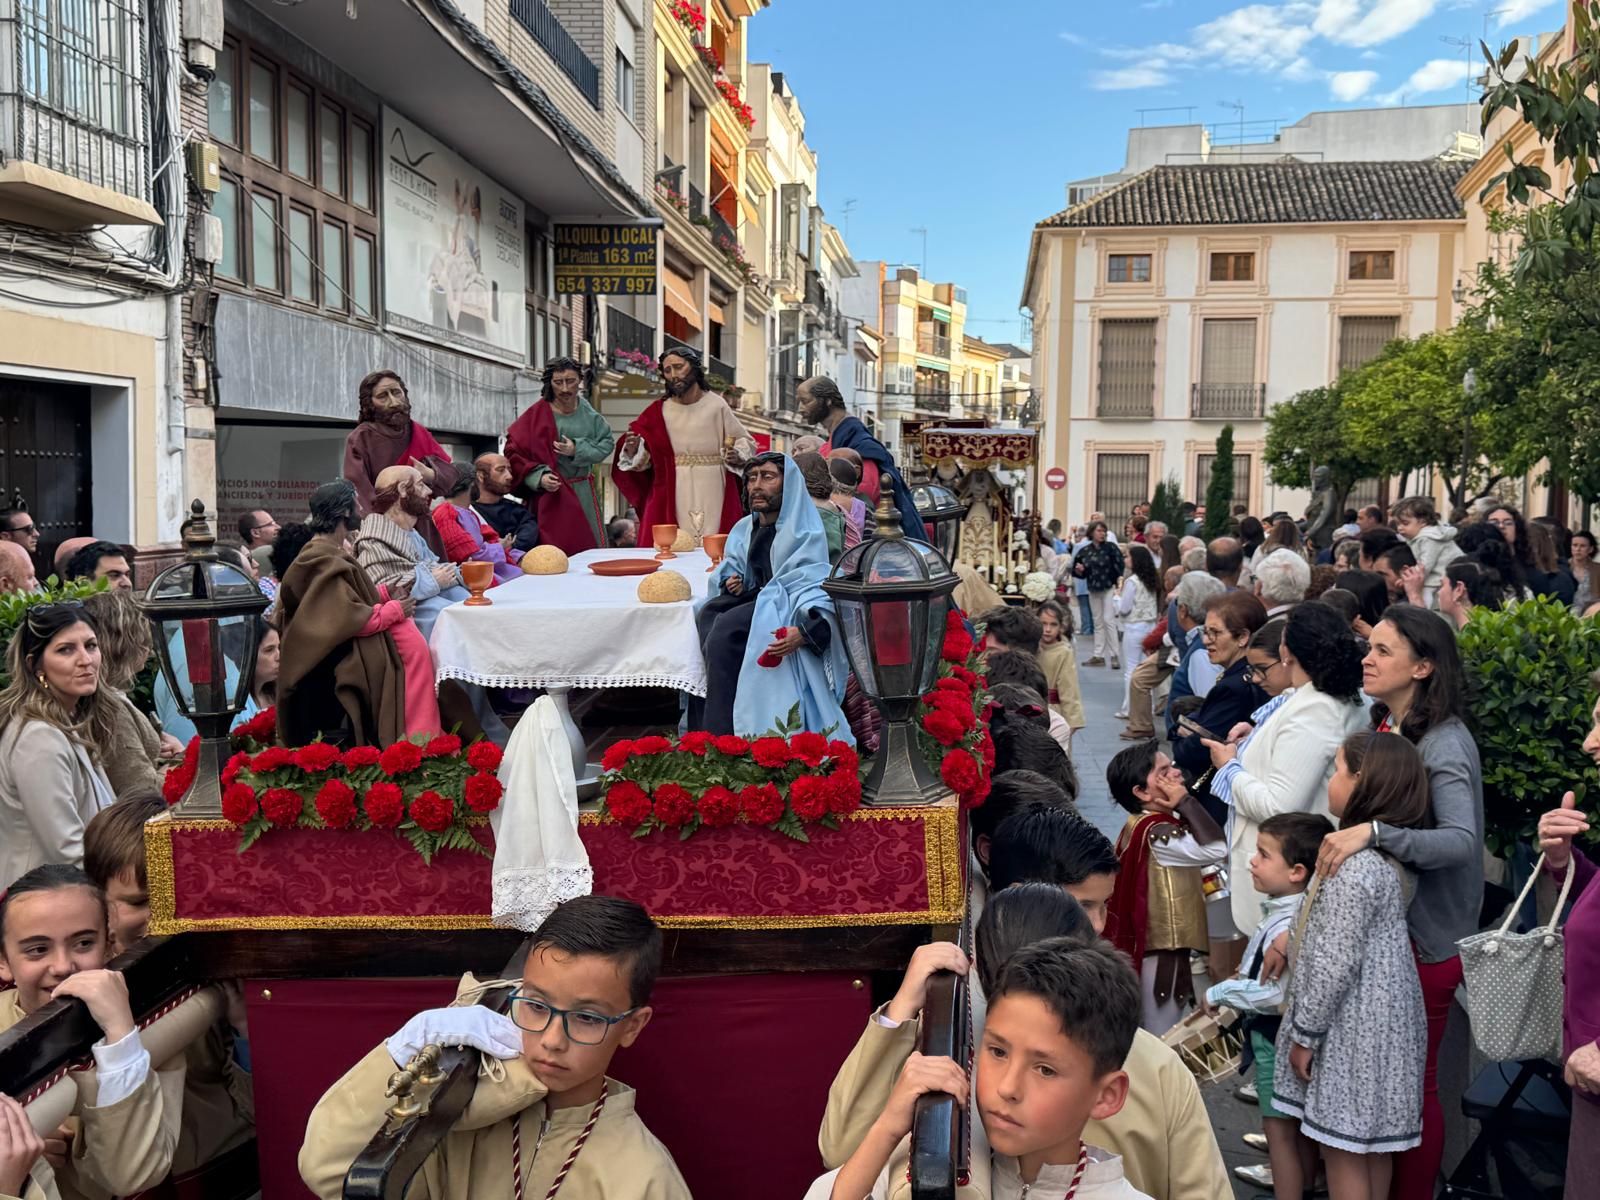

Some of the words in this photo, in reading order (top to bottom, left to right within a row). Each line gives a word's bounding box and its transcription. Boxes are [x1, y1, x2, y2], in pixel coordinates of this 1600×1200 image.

[556, 227, 609, 245] ALQUILO
[613, 227, 655, 244] LOCAL
[570, 247, 599, 263] Planta
[602, 247, 630, 264] 163
[556, 277, 586, 292] 654
[591, 277, 620, 292] 337
[626, 277, 654, 293] 997
